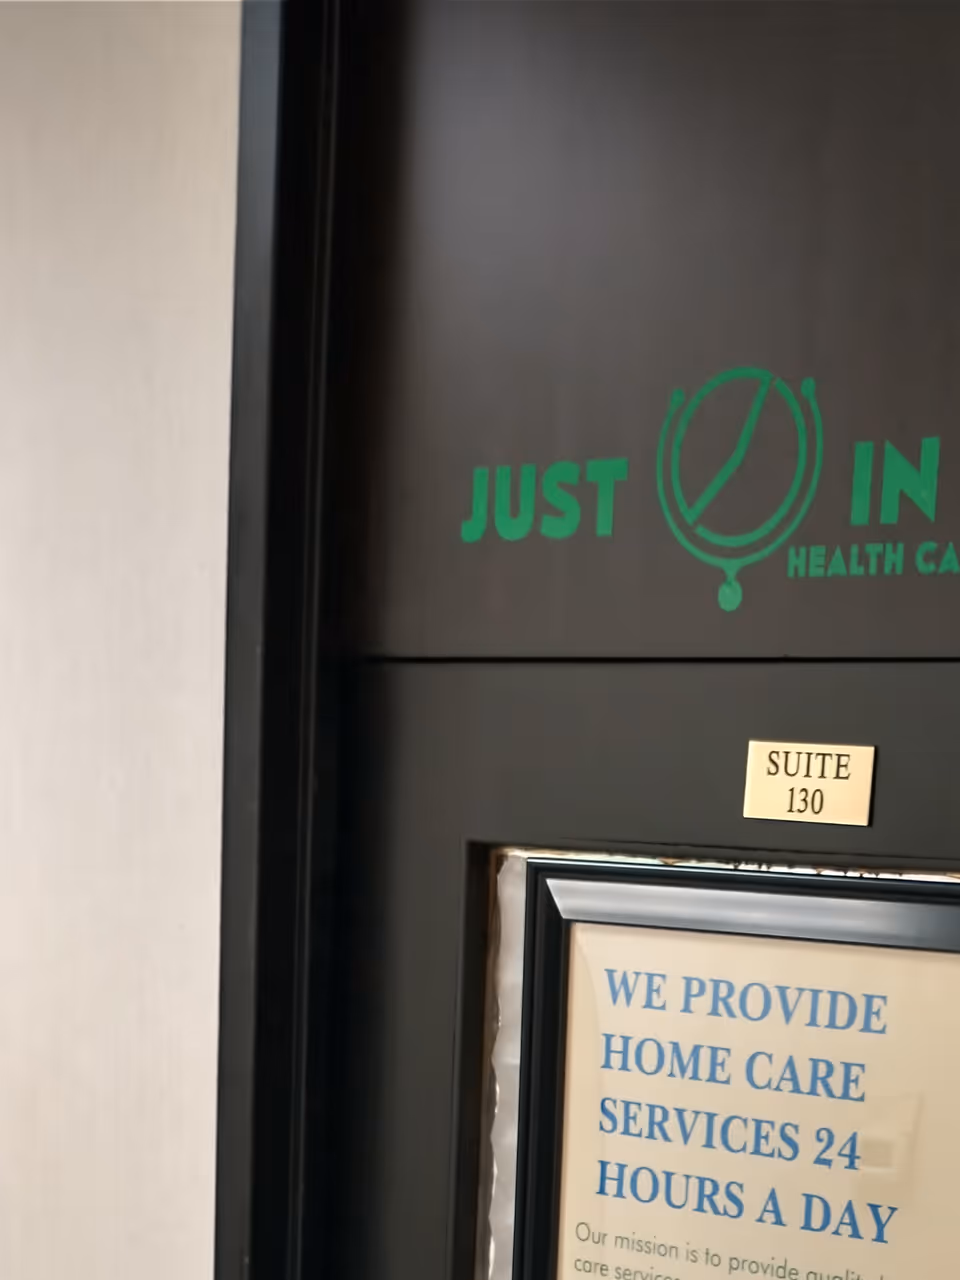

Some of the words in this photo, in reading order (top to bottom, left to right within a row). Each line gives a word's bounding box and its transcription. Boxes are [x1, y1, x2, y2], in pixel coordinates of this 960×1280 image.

[461, 458, 628, 543] JUST
[850, 436, 941, 526] IN
[787, 543, 903, 578] HEALTH
[766, 750, 852, 781] SUITE
[786, 786, 825, 816] 130
[604, 968, 667, 1011] WE
[680, 976, 888, 1035] PROVIDE
[600, 1033, 731, 1085] HOME
[745, 1051, 866, 1102] CARE
[599, 1097, 800, 1161] SERVICES
[813, 1127, 861, 1170] 24
[596, 1160, 745, 1219] HOURS
[755, 1187, 787, 1227] A
[800, 1193, 898, 1244] DAY
[574, 1255, 609, 1277] care
[575, 1222, 607, 1246] Our
[614, 1231, 678, 1260] mission
[685, 1242, 698, 1264] is
[705, 1248, 721, 1267] to
